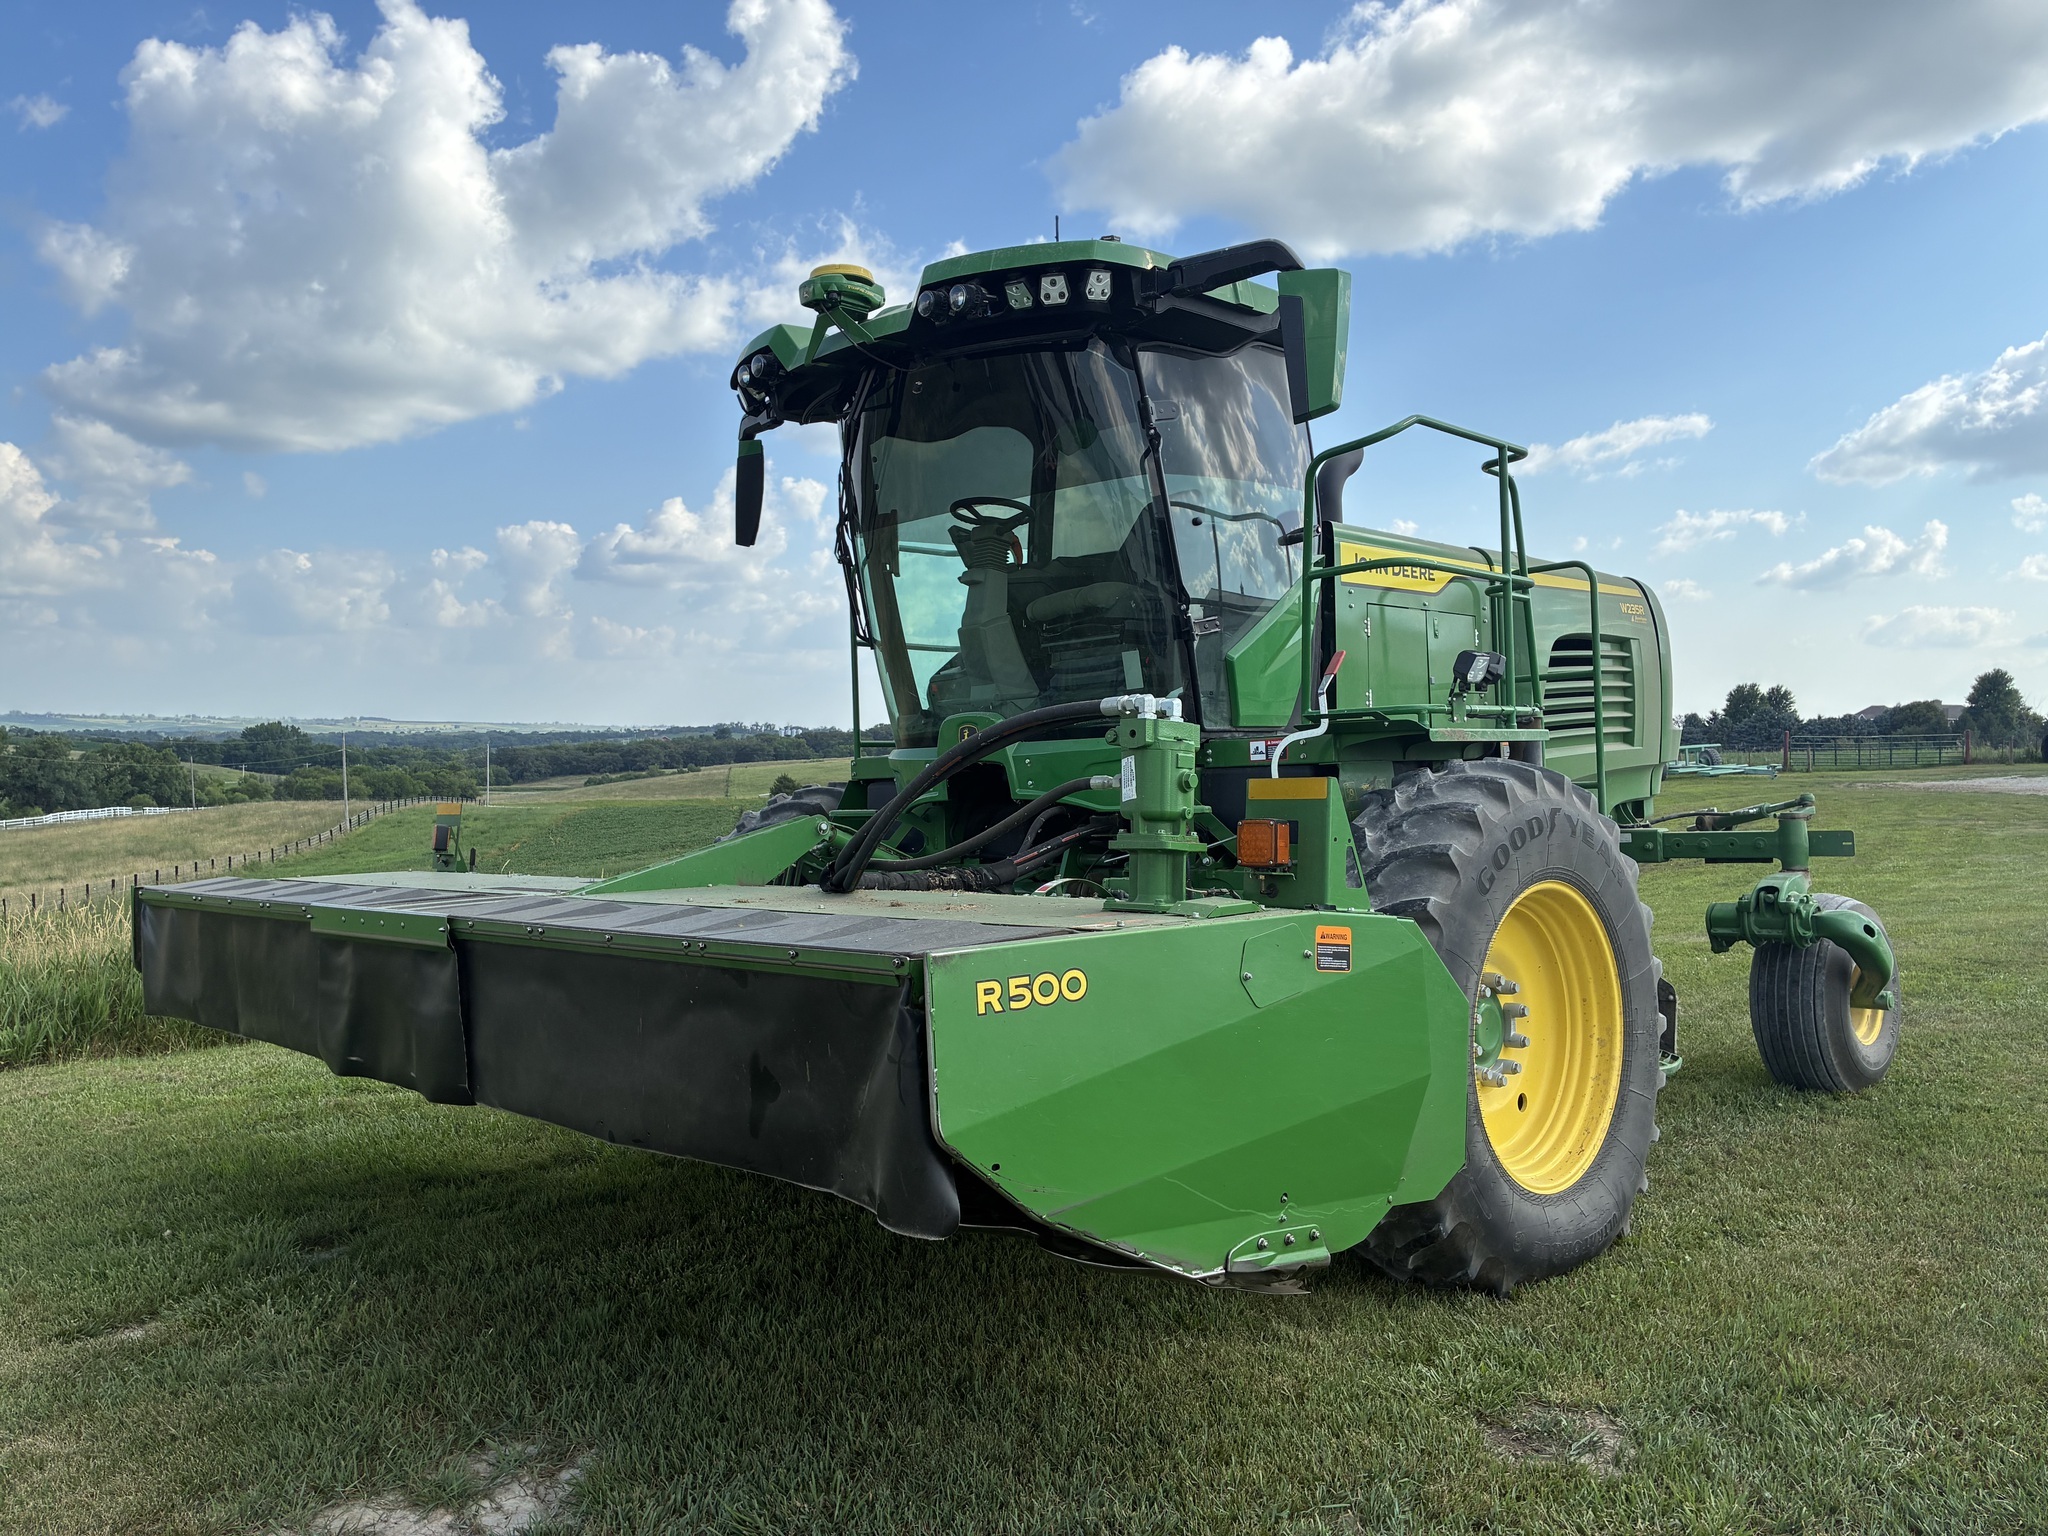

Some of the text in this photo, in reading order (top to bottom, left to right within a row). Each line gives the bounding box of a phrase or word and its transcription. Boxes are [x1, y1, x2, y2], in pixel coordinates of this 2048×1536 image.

[1392, 565, 1436, 582] DEERE
[1619, 602, 1645, 615] W235R
[1476, 807, 1625, 896] GOODYEAR
[1325, 933, 1348, 942] WARNING
